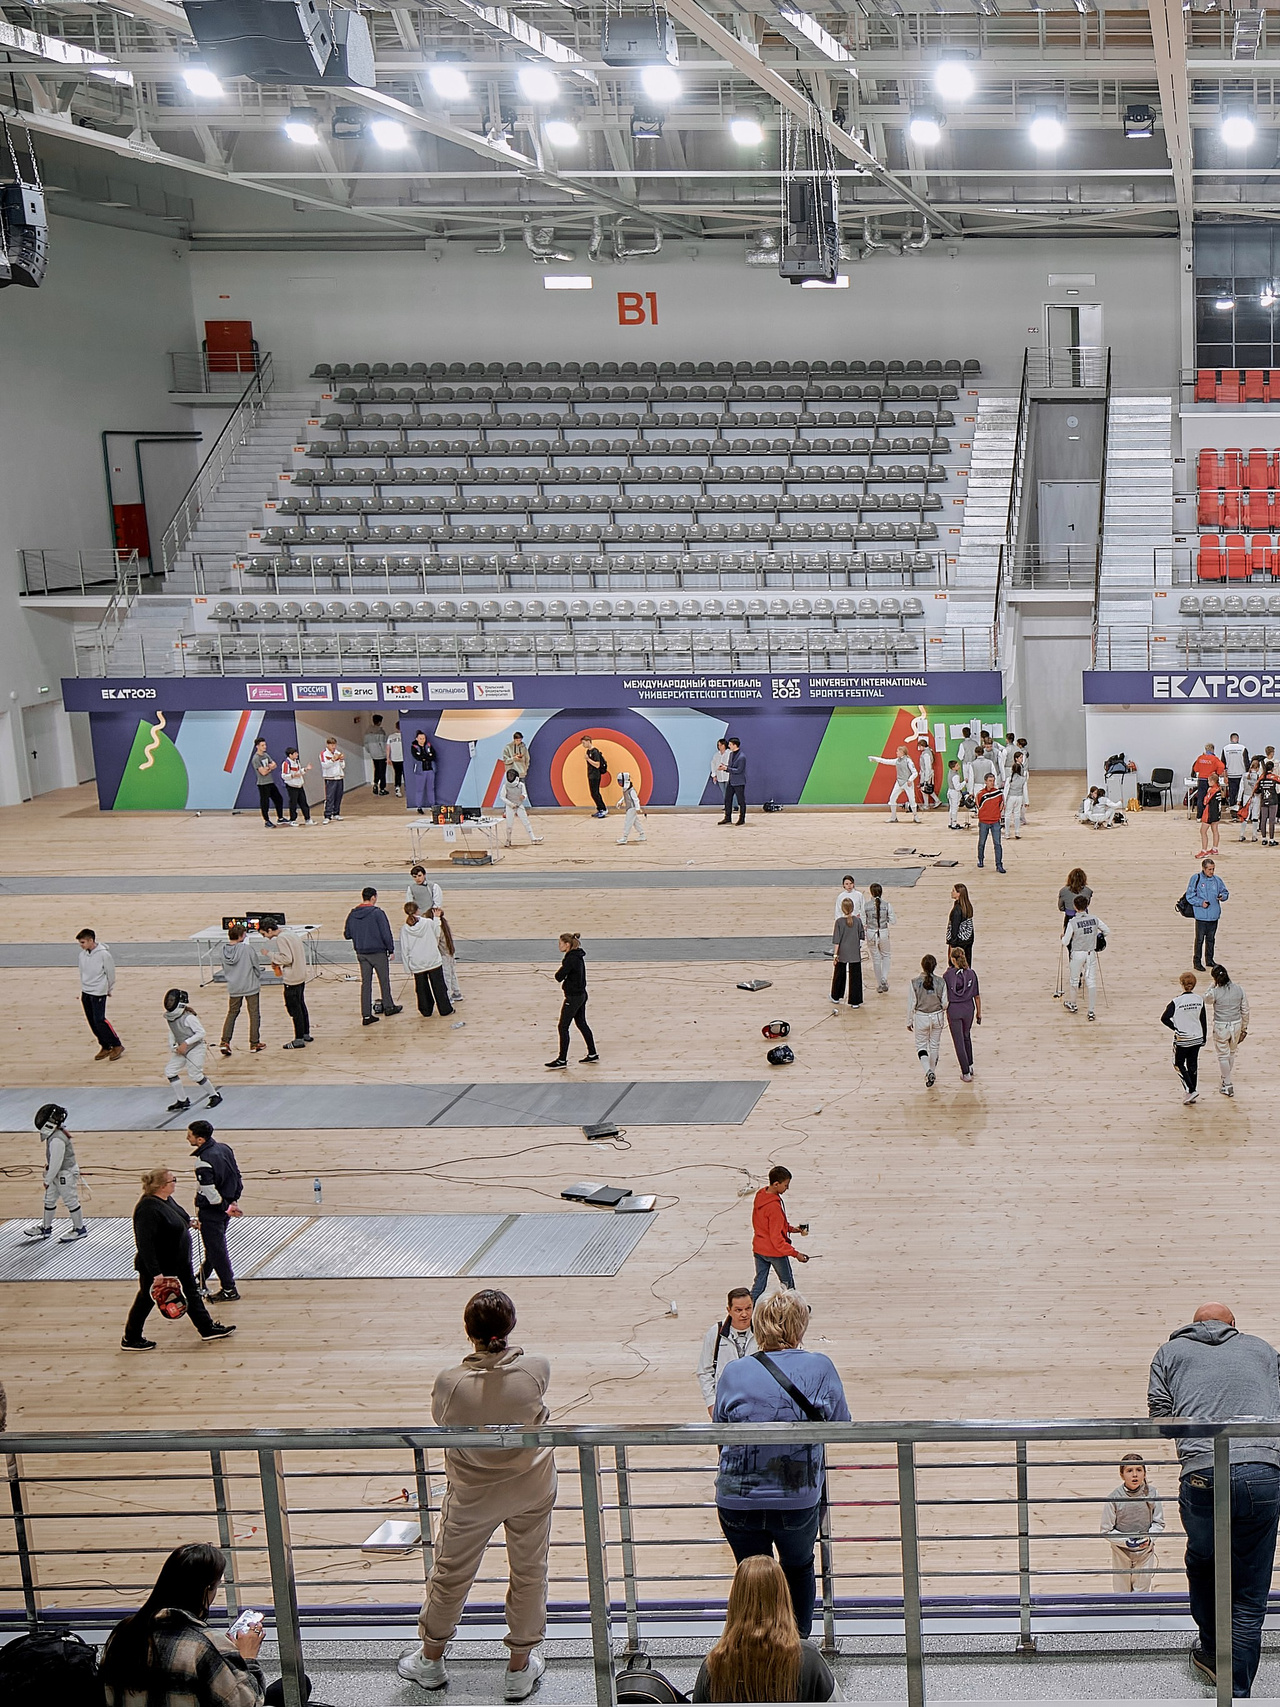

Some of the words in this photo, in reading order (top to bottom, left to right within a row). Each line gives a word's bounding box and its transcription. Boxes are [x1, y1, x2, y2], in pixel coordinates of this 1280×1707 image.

[617, 292, 658, 325] B1
[623, 678, 707, 689] МЕЖДУНАРОДНЫЙ
[708, 679, 762, 688] ФЕСТИВАЛЬ
[771, 678, 801, 688] EKAT
[809, 678, 860, 687] UNIVERSITY
[860, 677, 928, 687] INTERNATIONAL
[101, 688, 157, 699] EKAT2023
[354, 688, 373, 696] 2ГИС
[638, 690, 728, 700] УНИВЕРСИТЕТСКОГО
[729, 690, 763, 699] СПОРТА
[772, 688, 801, 699] 2023
[809, 689, 844, 698] SPORTS
[845, 689, 885, 698] FESTIVAL
